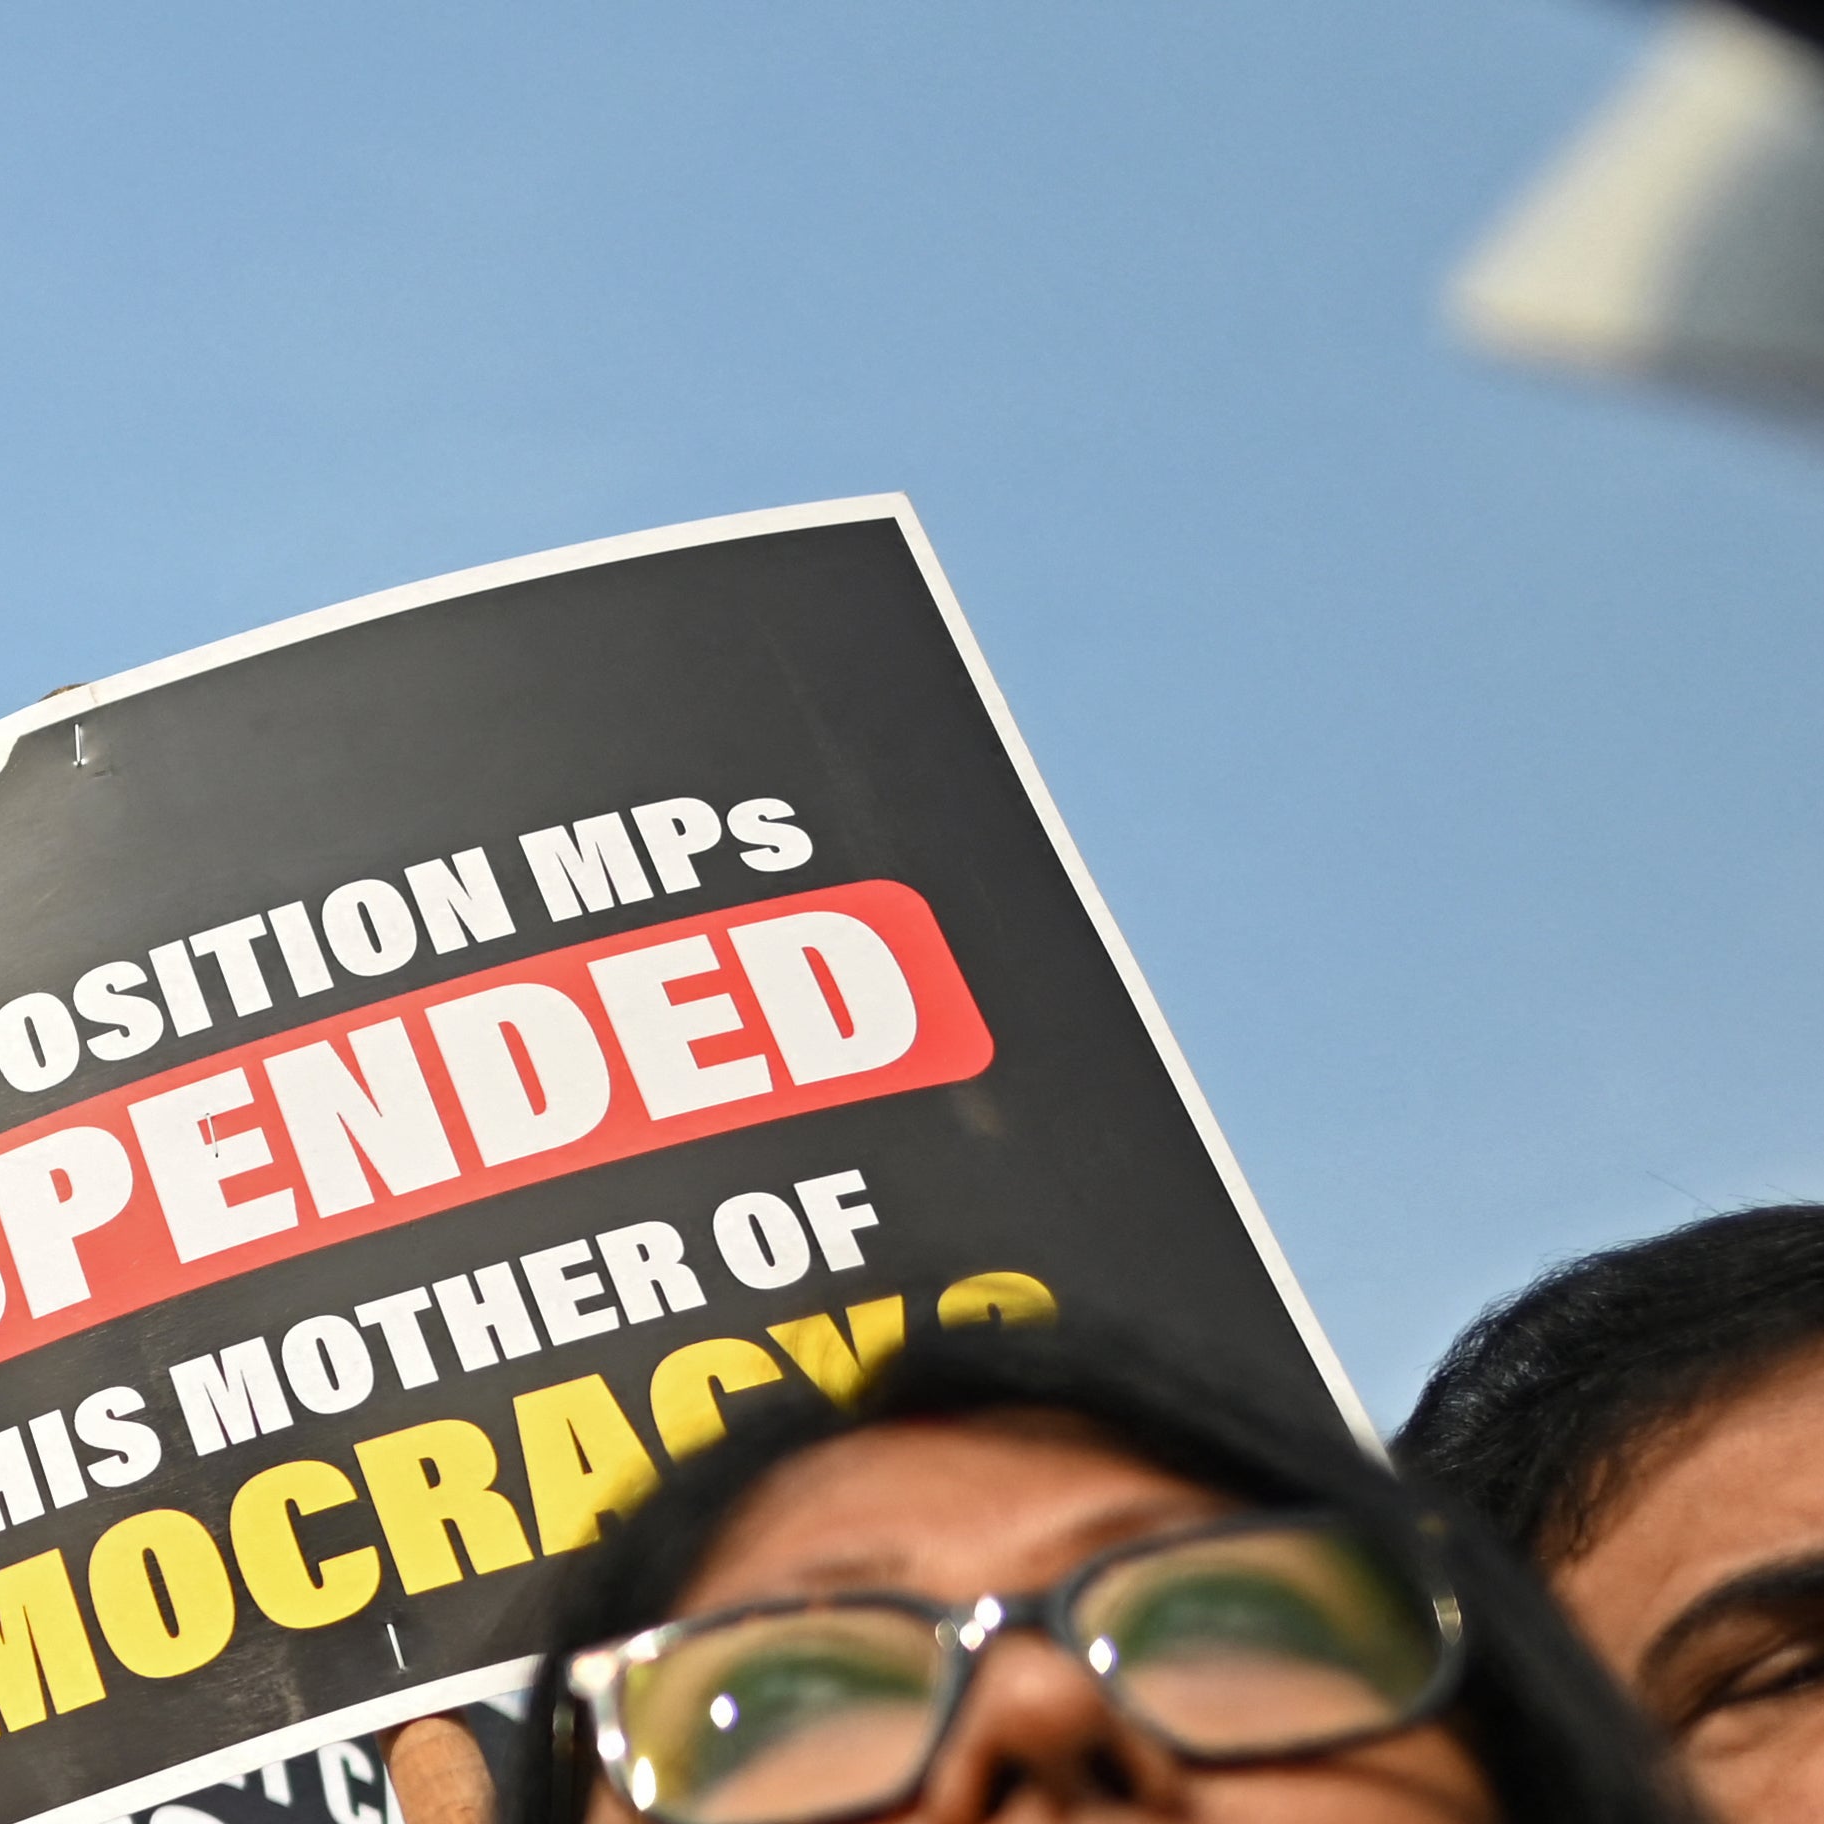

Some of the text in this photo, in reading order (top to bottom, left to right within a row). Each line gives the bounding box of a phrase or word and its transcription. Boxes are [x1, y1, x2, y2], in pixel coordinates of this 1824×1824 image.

[519, 797, 814, 923] MPs
[168, 1220, 708, 1459] MOTHER
[711, 1169, 880, 1289] OF
